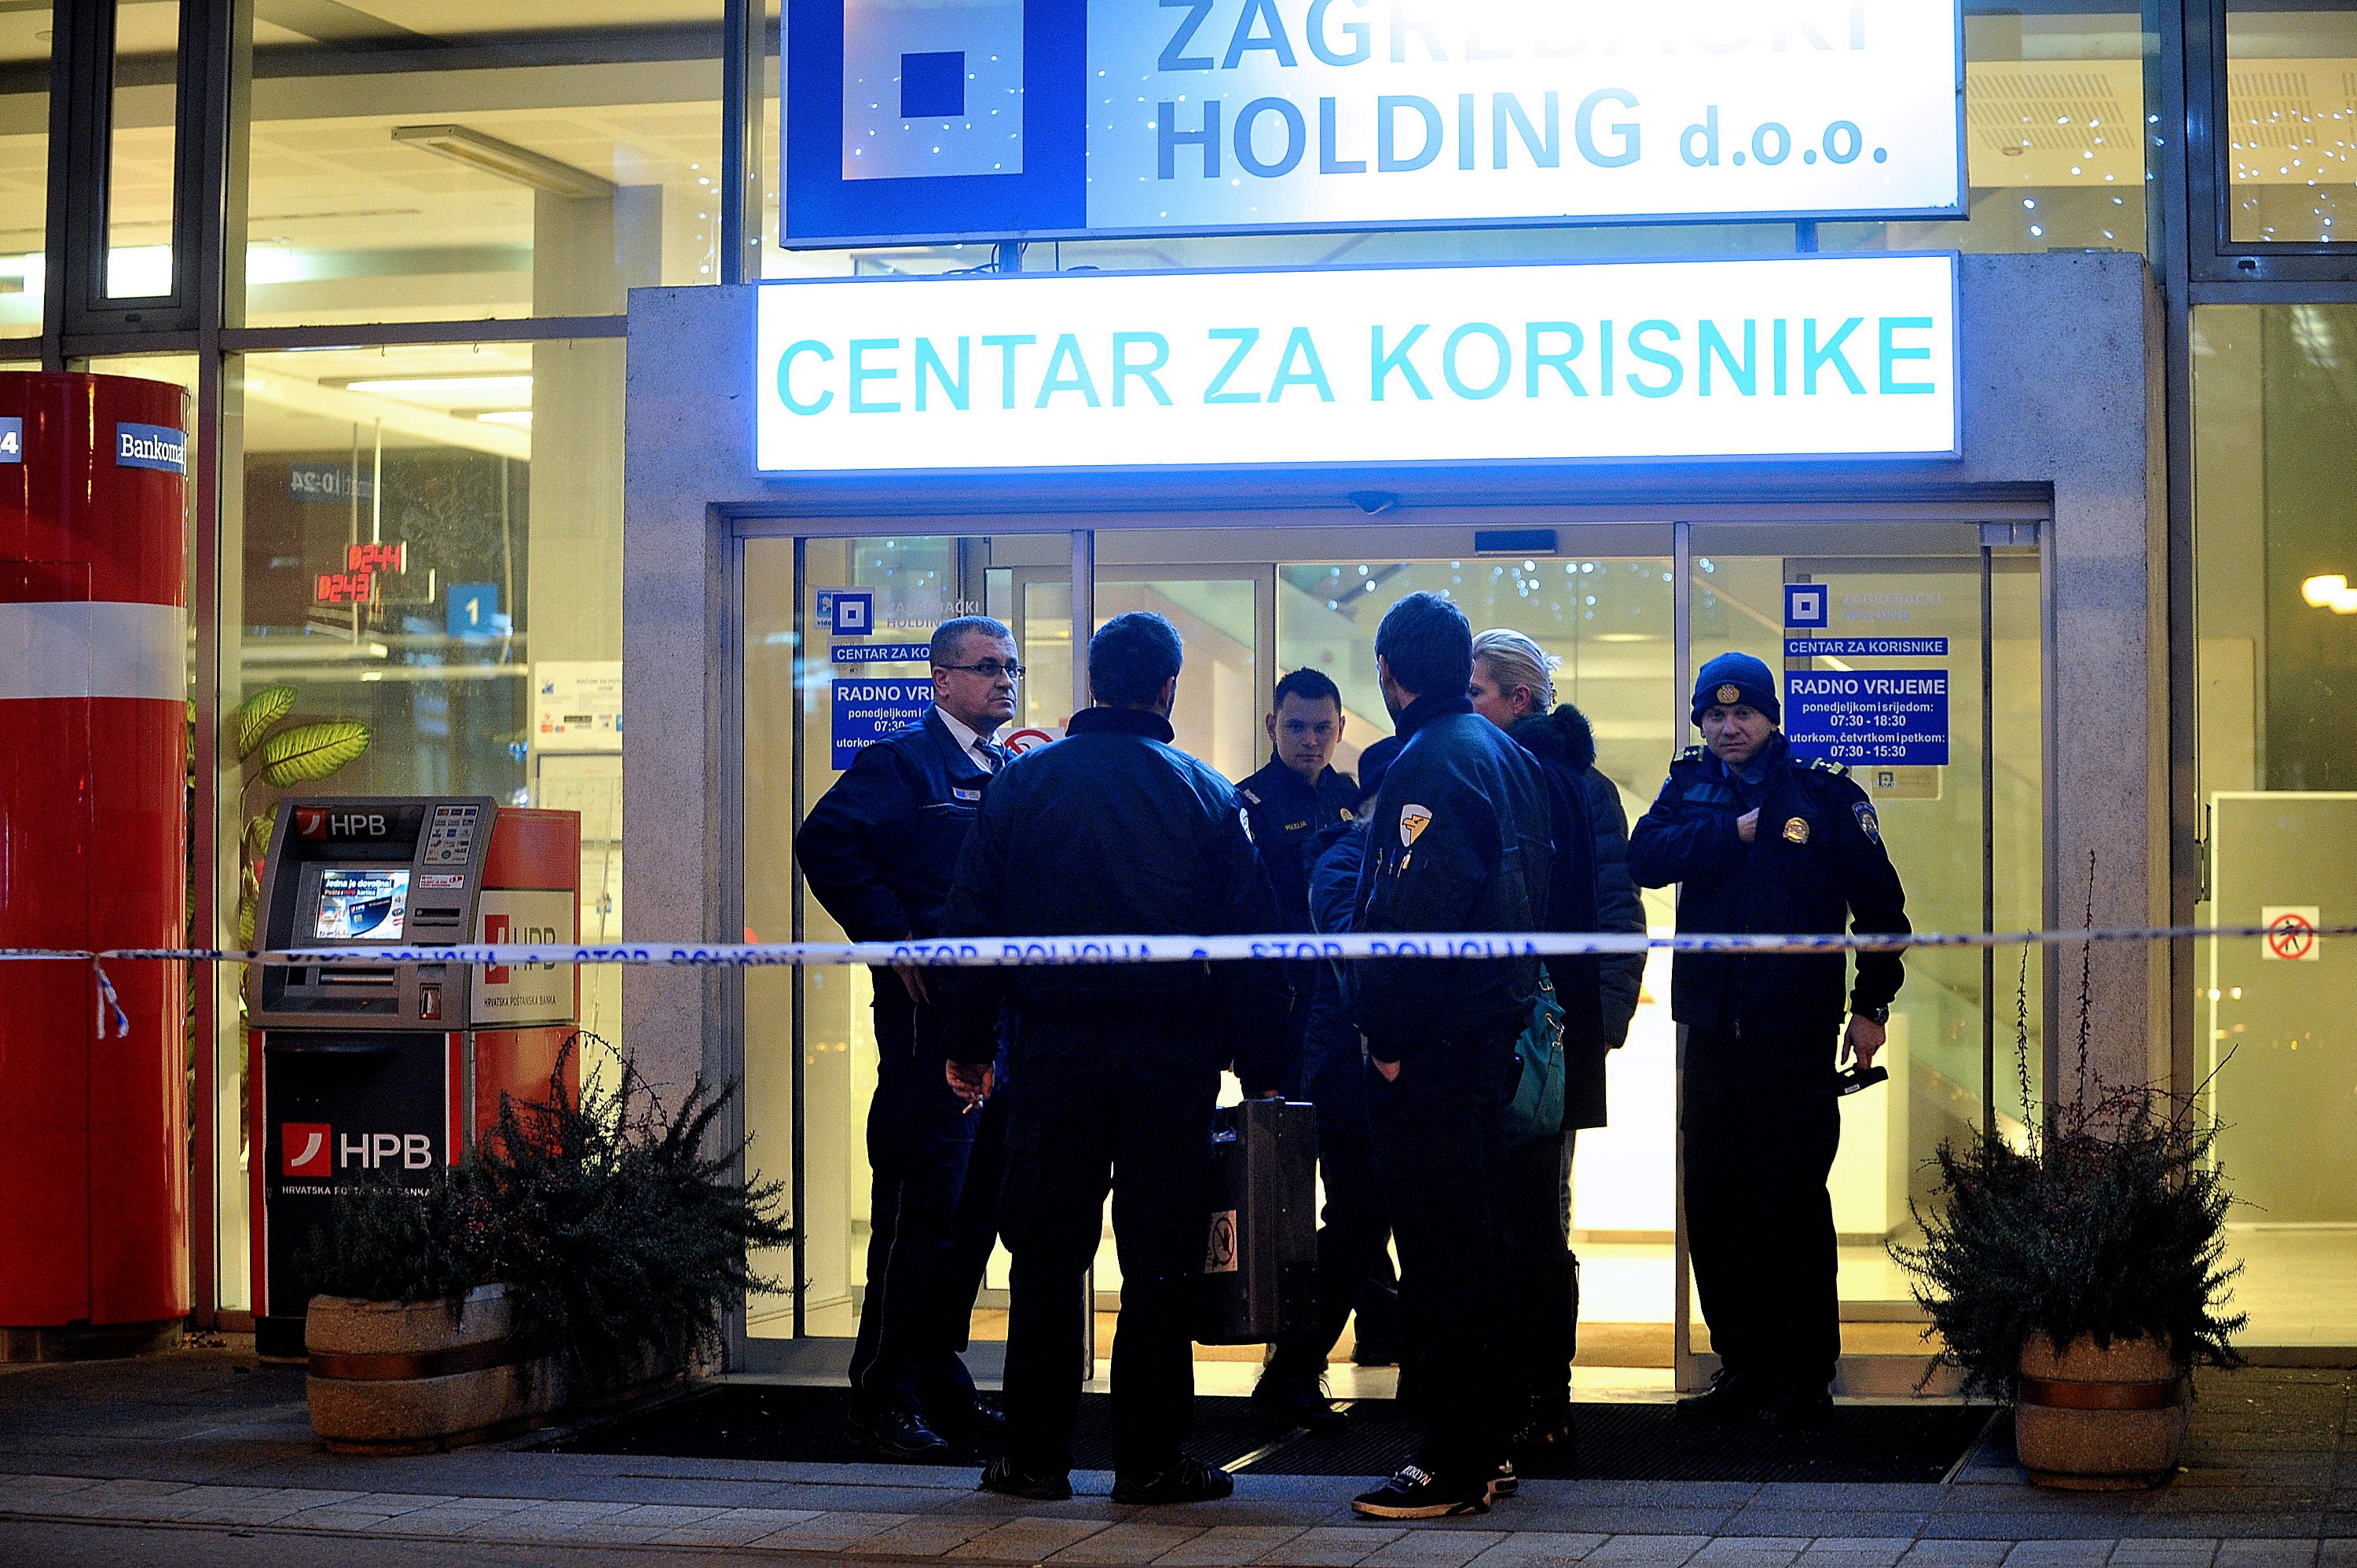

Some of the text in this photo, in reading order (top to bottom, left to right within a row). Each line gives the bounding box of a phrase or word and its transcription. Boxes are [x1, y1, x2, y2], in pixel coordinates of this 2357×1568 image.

[1157, 87, 1887, 180] HOLDING d.o.o.
[776, 317, 1935, 416] CENTAR ZA KORISNIKE
[466, 598, 479, 625] 1
[837, 648, 887, 660] CENTAR
[891, 648, 907, 659] ZA
[1790, 641, 1943, 653] CENTAR ZA KORISNIKE
[838, 686, 901, 702] RADNO
[1791, 679, 1945, 694] RADNO VRIJEME
[1831, 716, 1864, 727] 07:30
[1874, 716, 1906, 727] 18:30
[1831, 746, 1864, 757] 07:30
[1874, 746, 1906, 757] 15:30
[332, 814, 386, 837] HPB
[340, 1133, 432, 1169] HPB
[282, 1185, 331, 1195] HRVATSKA
